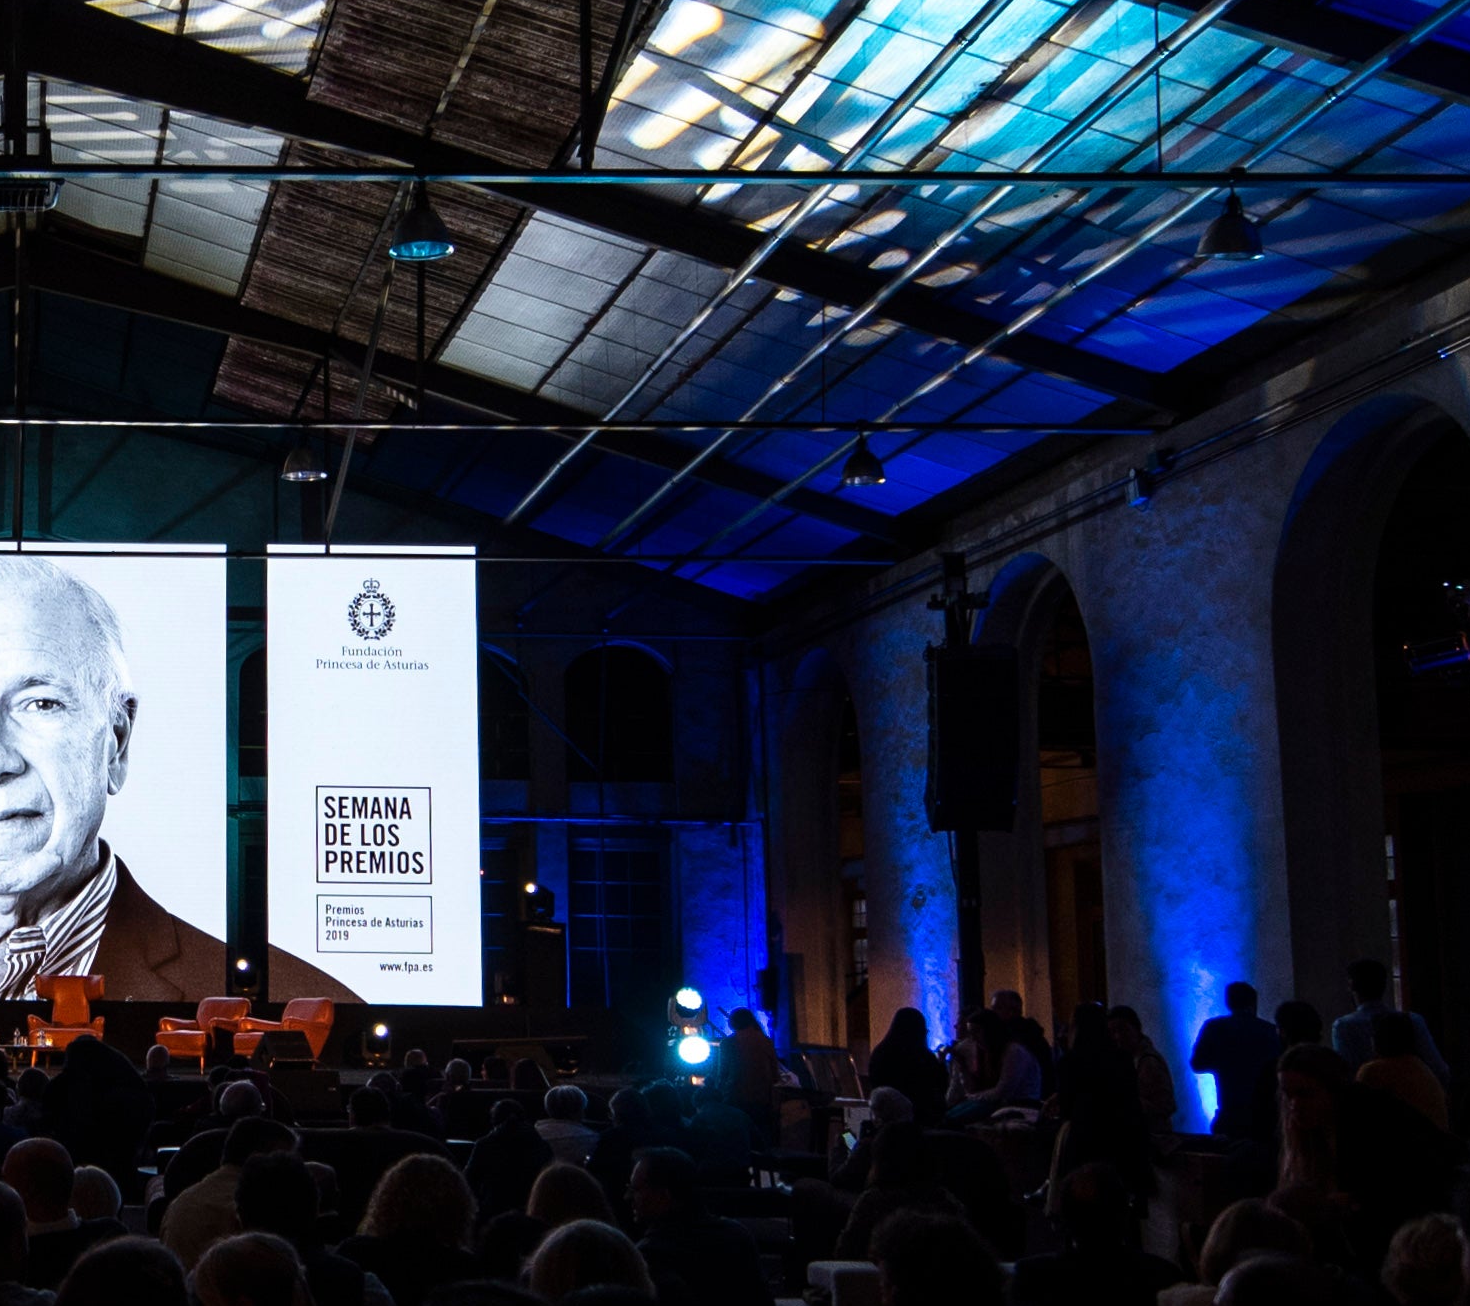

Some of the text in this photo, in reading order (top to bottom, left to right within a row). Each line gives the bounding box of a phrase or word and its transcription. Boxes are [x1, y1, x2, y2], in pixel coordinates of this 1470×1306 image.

[341, 645, 403, 657] Fundación
[316, 658, 430, 671] Princesa de Asturias
[324, 796, 412, 820] SEMANA
[325, 823, 399, 847] DE LOS
[325, 850, 424, 874] PREMIOS
[325, 903, 365, 915] Premios
[325, 915, 425, 929] Princesa de Asturias
[325, 929, 350, 941] 2019
[379, 960, 434, 975] www.fpa.es
